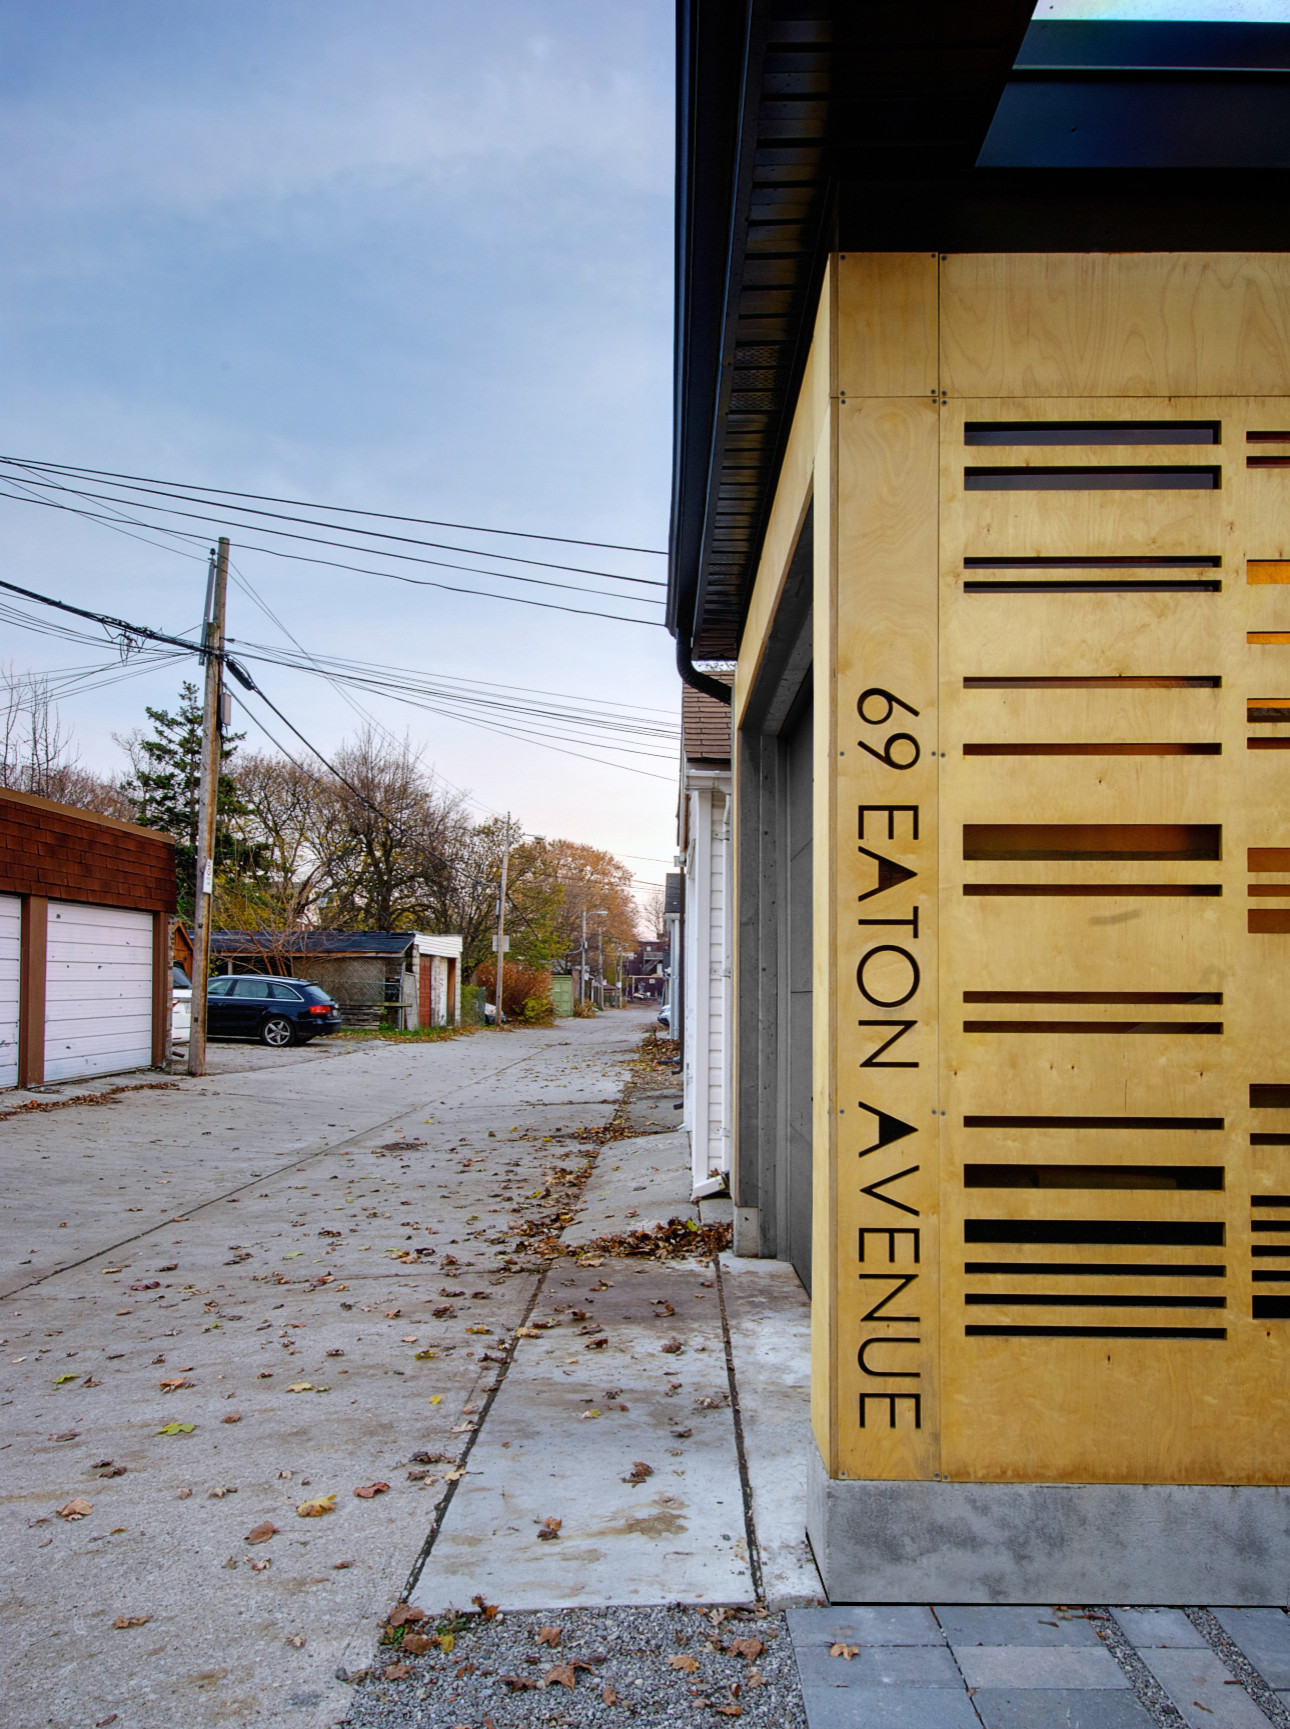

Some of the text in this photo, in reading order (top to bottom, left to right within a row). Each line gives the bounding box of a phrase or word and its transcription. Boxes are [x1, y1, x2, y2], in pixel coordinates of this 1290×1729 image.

[856, 687, 921, 1430] 69 EATON AVENUE
